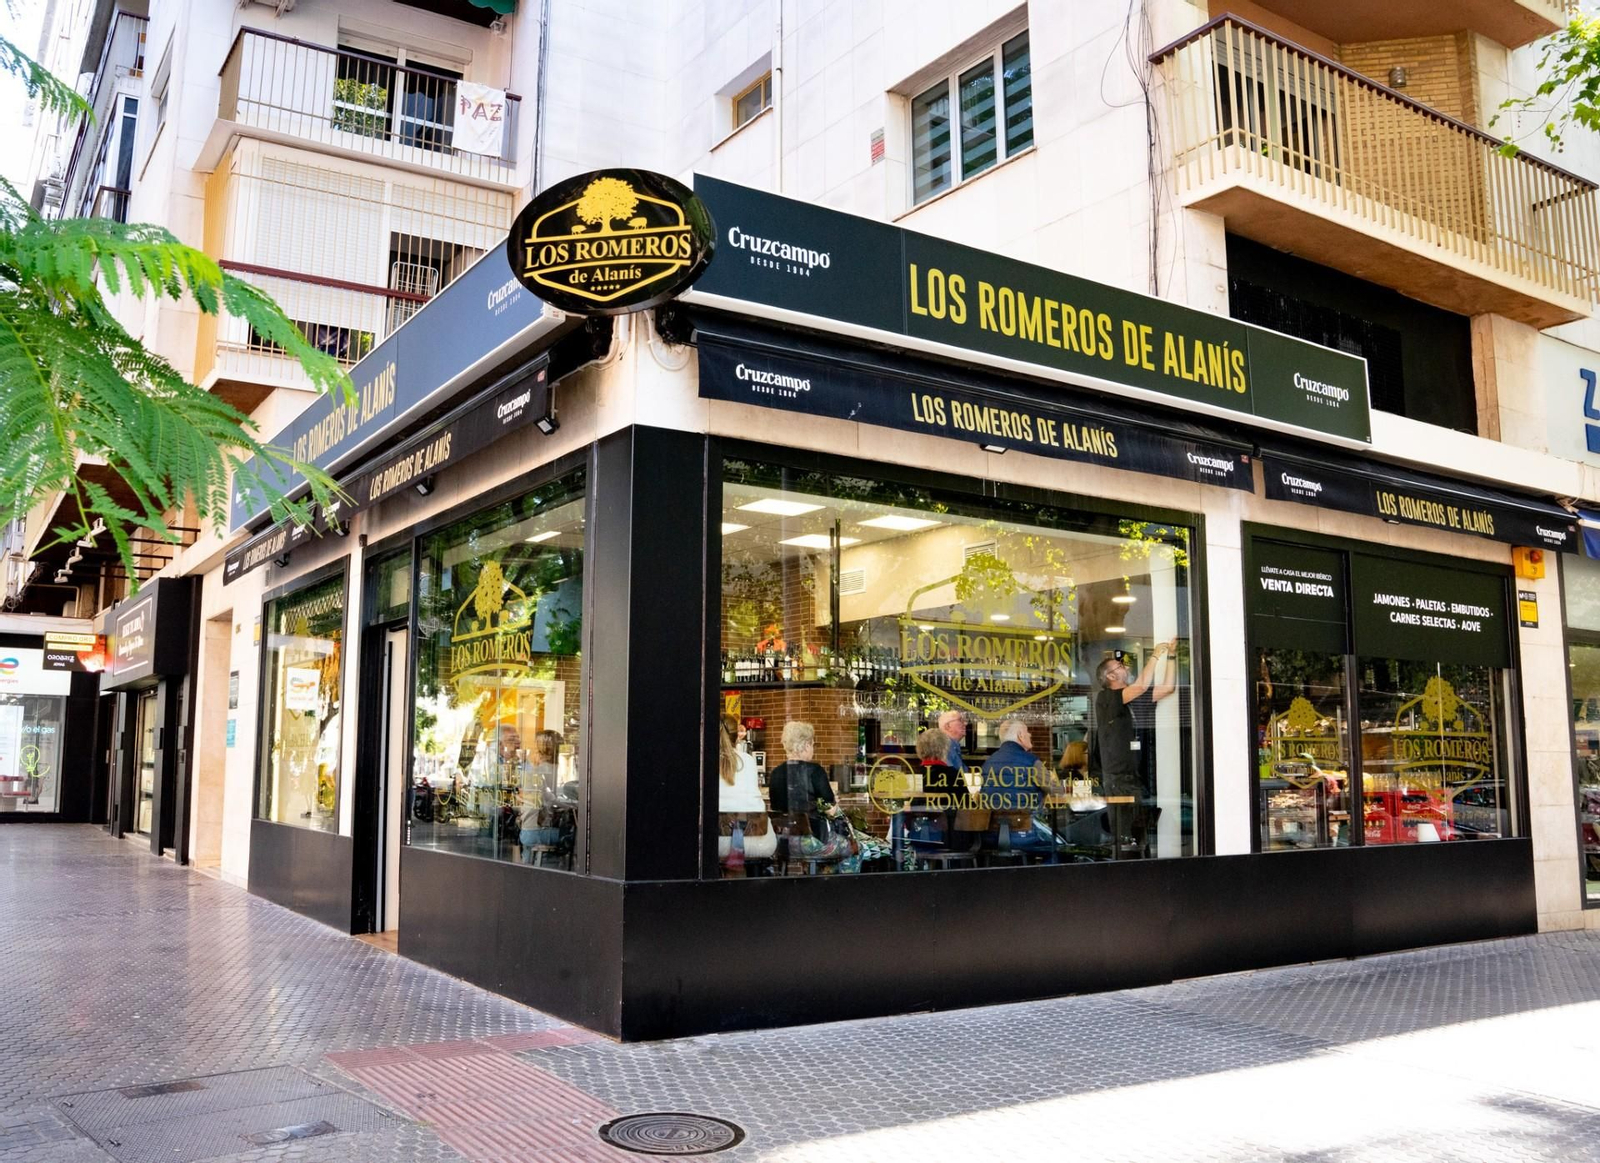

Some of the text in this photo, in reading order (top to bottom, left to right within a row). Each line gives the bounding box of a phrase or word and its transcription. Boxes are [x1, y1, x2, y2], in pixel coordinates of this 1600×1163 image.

[461, 95, 502, 121] PAZ
[525, 233, 692, 269] LOS ROMEROS
[728, 226, 831, 269] Cruzcampo
[569, 265, 642, 284] de Alanís
[750, 256, 780, 270] DESDE
[488, 277, 523, 310] Cruzcam
[909, 263, 1247, 394] LOS ROMEROS DE ALANÍS
[736, 363, 811, 391] Cruzcampo
[1293, 372, 1350, 401] Cruzcampo
[292, 361, 396, 474] LOS ROMEROS DE ALANÍS
[911, 393, 1118, 458] LOS ROMEROS DE ALANÍS
[369, 430, 452, 501] LOS ROMEROS DE ALANÍS
[1187, 452, 1234, 472] Cruzcampo
[1281, 472, 1323, 492] Cruzcampo
[1376, 491, 1495, 535] LOS ROMEROS DE ALANÍS
[1260, 577, 1334, 598] VENTA DIRECTA
[1373, 593, 1490, 618] JAMONES PALETAS EMBUTIDOS
[1390, 611, 1481, 632] CARNES SELECTAS AOVE
[450, 630, 532, 673] LOS ROMEROS
[901, 630, 1073, 672] LOS ROMEROS
[952, 675, 973, 691] de
[1288, 743, 1340, 760] ROMEROS
[1393, 739, 1490, 763] LOS ROMEROS
[925, 765, 948, 787] La
[953, 761, 1062, 788] ABACERÍA
[1066, 771, 1079, 787] de
[925, 792, 1012, 810] ROMEROS
[1017, 793, 1040, 810] DE
